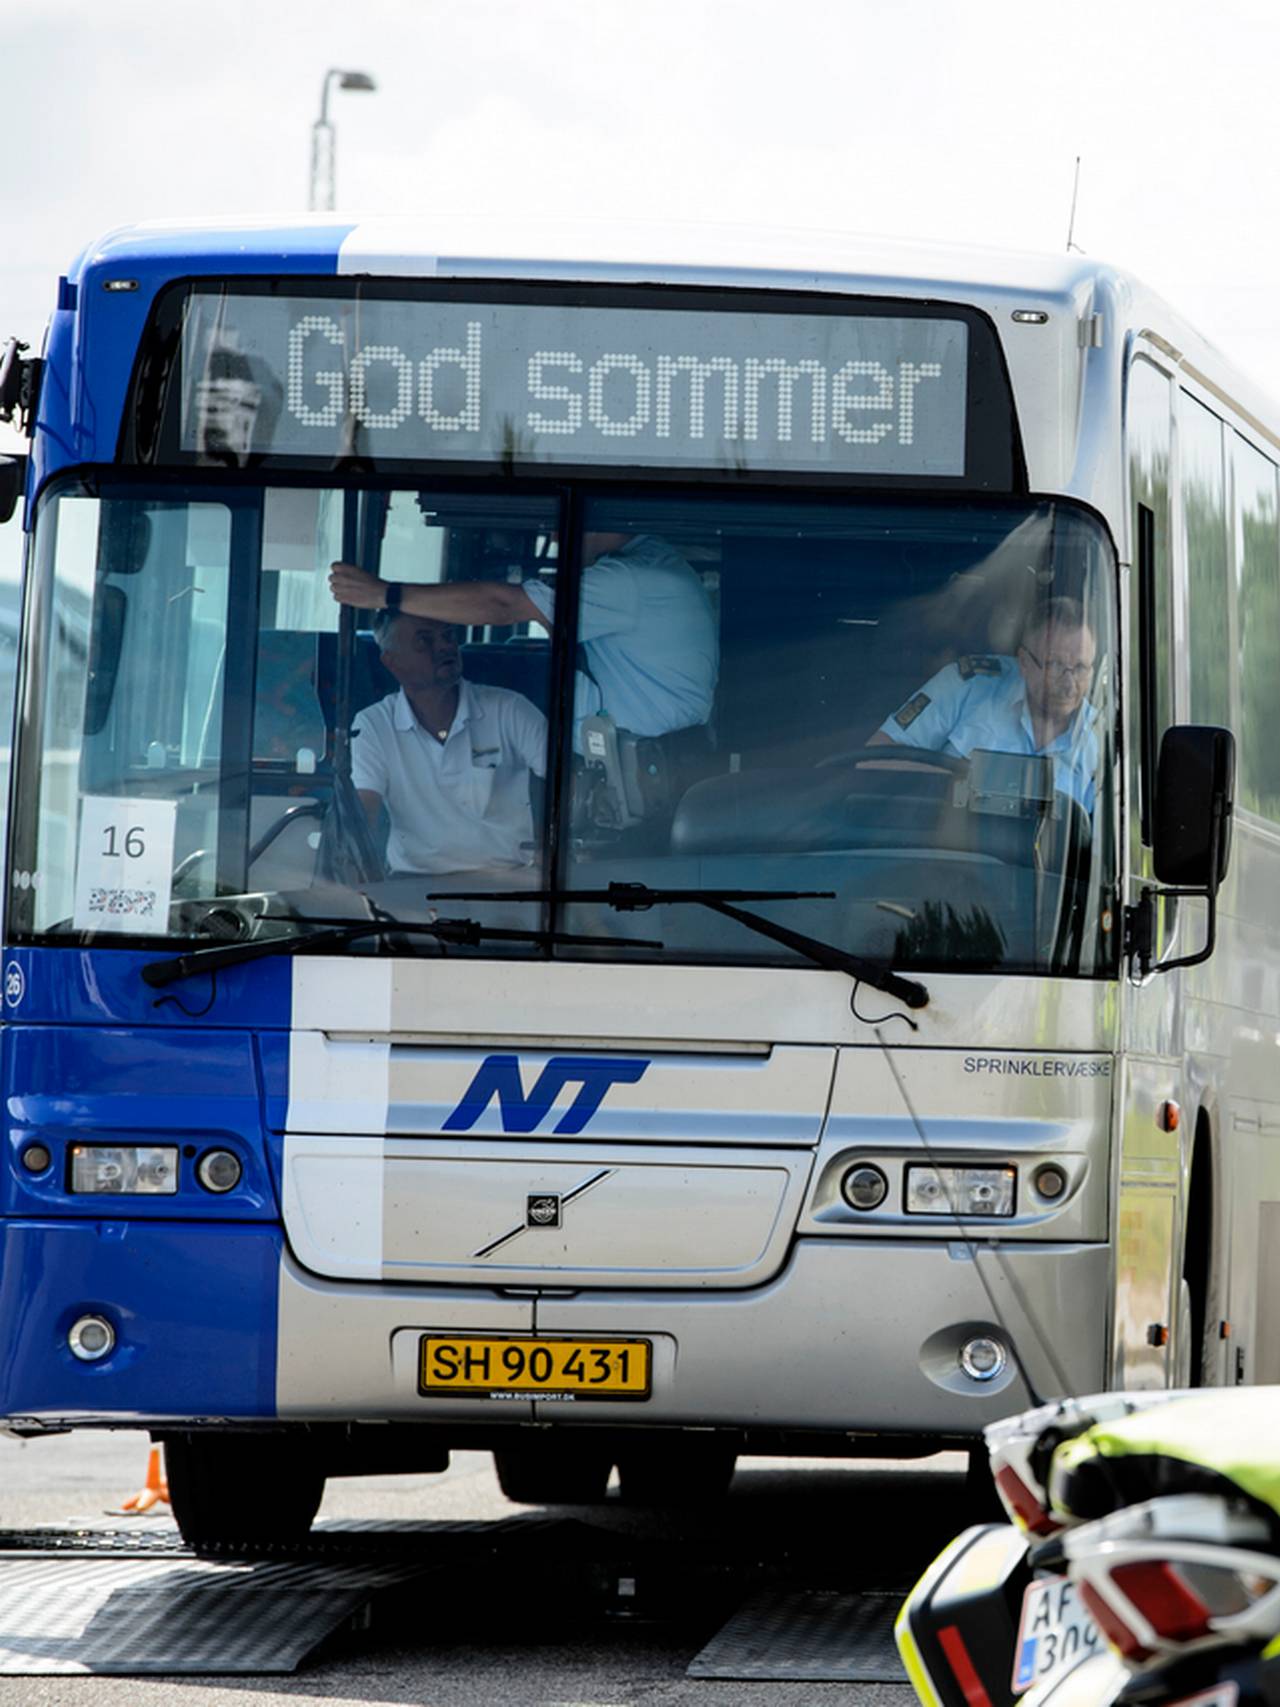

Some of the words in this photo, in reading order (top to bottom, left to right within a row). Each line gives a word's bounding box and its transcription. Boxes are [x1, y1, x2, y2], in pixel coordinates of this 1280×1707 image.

[288, 316, 482, 431] God
[528, 351, 942, 445] sommer
[102, 825, 145, 858] 16
[7, 973, 20, 995] 26
[964, 1057, 1110, 1077] SPRINKLERVÆSKE
[441, 1055, 652, 1134] NT
[433, 1345, 491, 1380] SH
[502, 1346, 553, 1383] 90
[561, 1349, 630, 1383] 431
